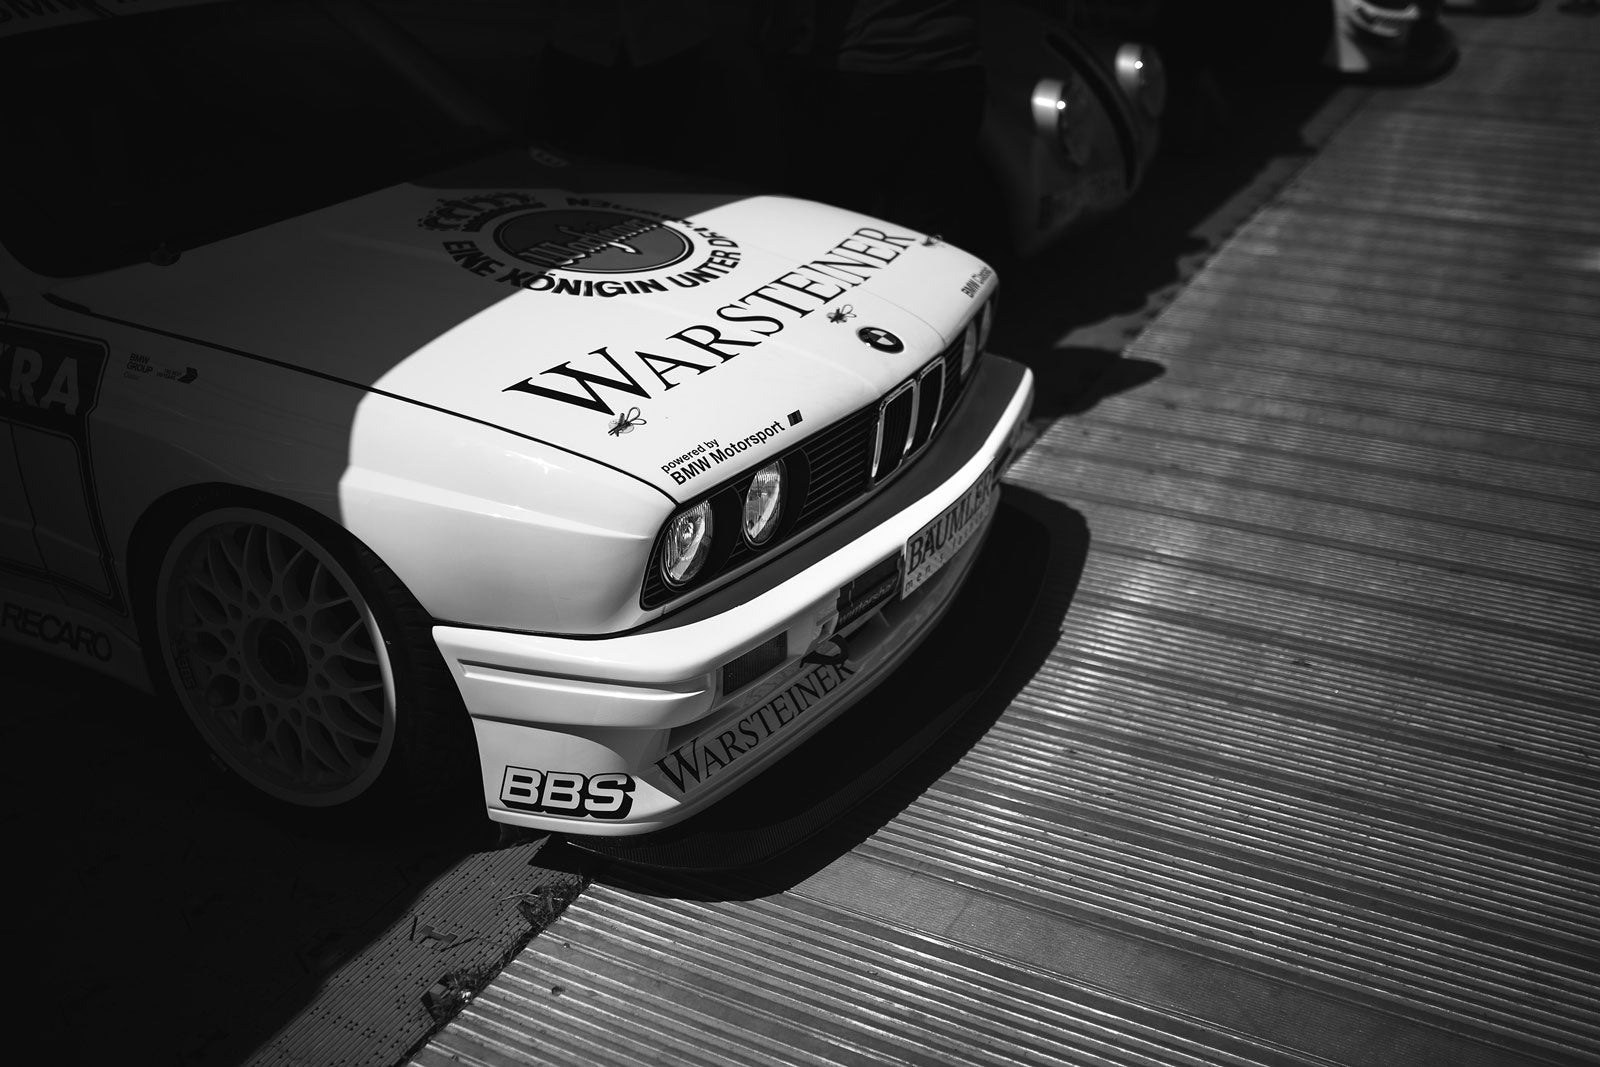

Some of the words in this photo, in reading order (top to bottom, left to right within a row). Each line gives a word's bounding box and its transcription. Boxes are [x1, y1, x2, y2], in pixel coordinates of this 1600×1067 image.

[442, 240, 505, 277] EINE
[495, 268, 668, 297] KÖNIGIN
[665, 250, 741, 288] UNTER
[502, 227, 916, 416] WARSTEINER
[126, 361, 153, 374] GROUP
[129, 352, 151, 364] BMW
[660, 444, 706, 474] powered
[703, 438, 720, 450] by
[669, 455, 711, 486] BMW
[708, 420, 786, 465] Motorsport
[1, 601, 113, 662] RECARO
[653, 660, 855, 794] WARSTEINER
[499, 765, 637, 820] BBS
